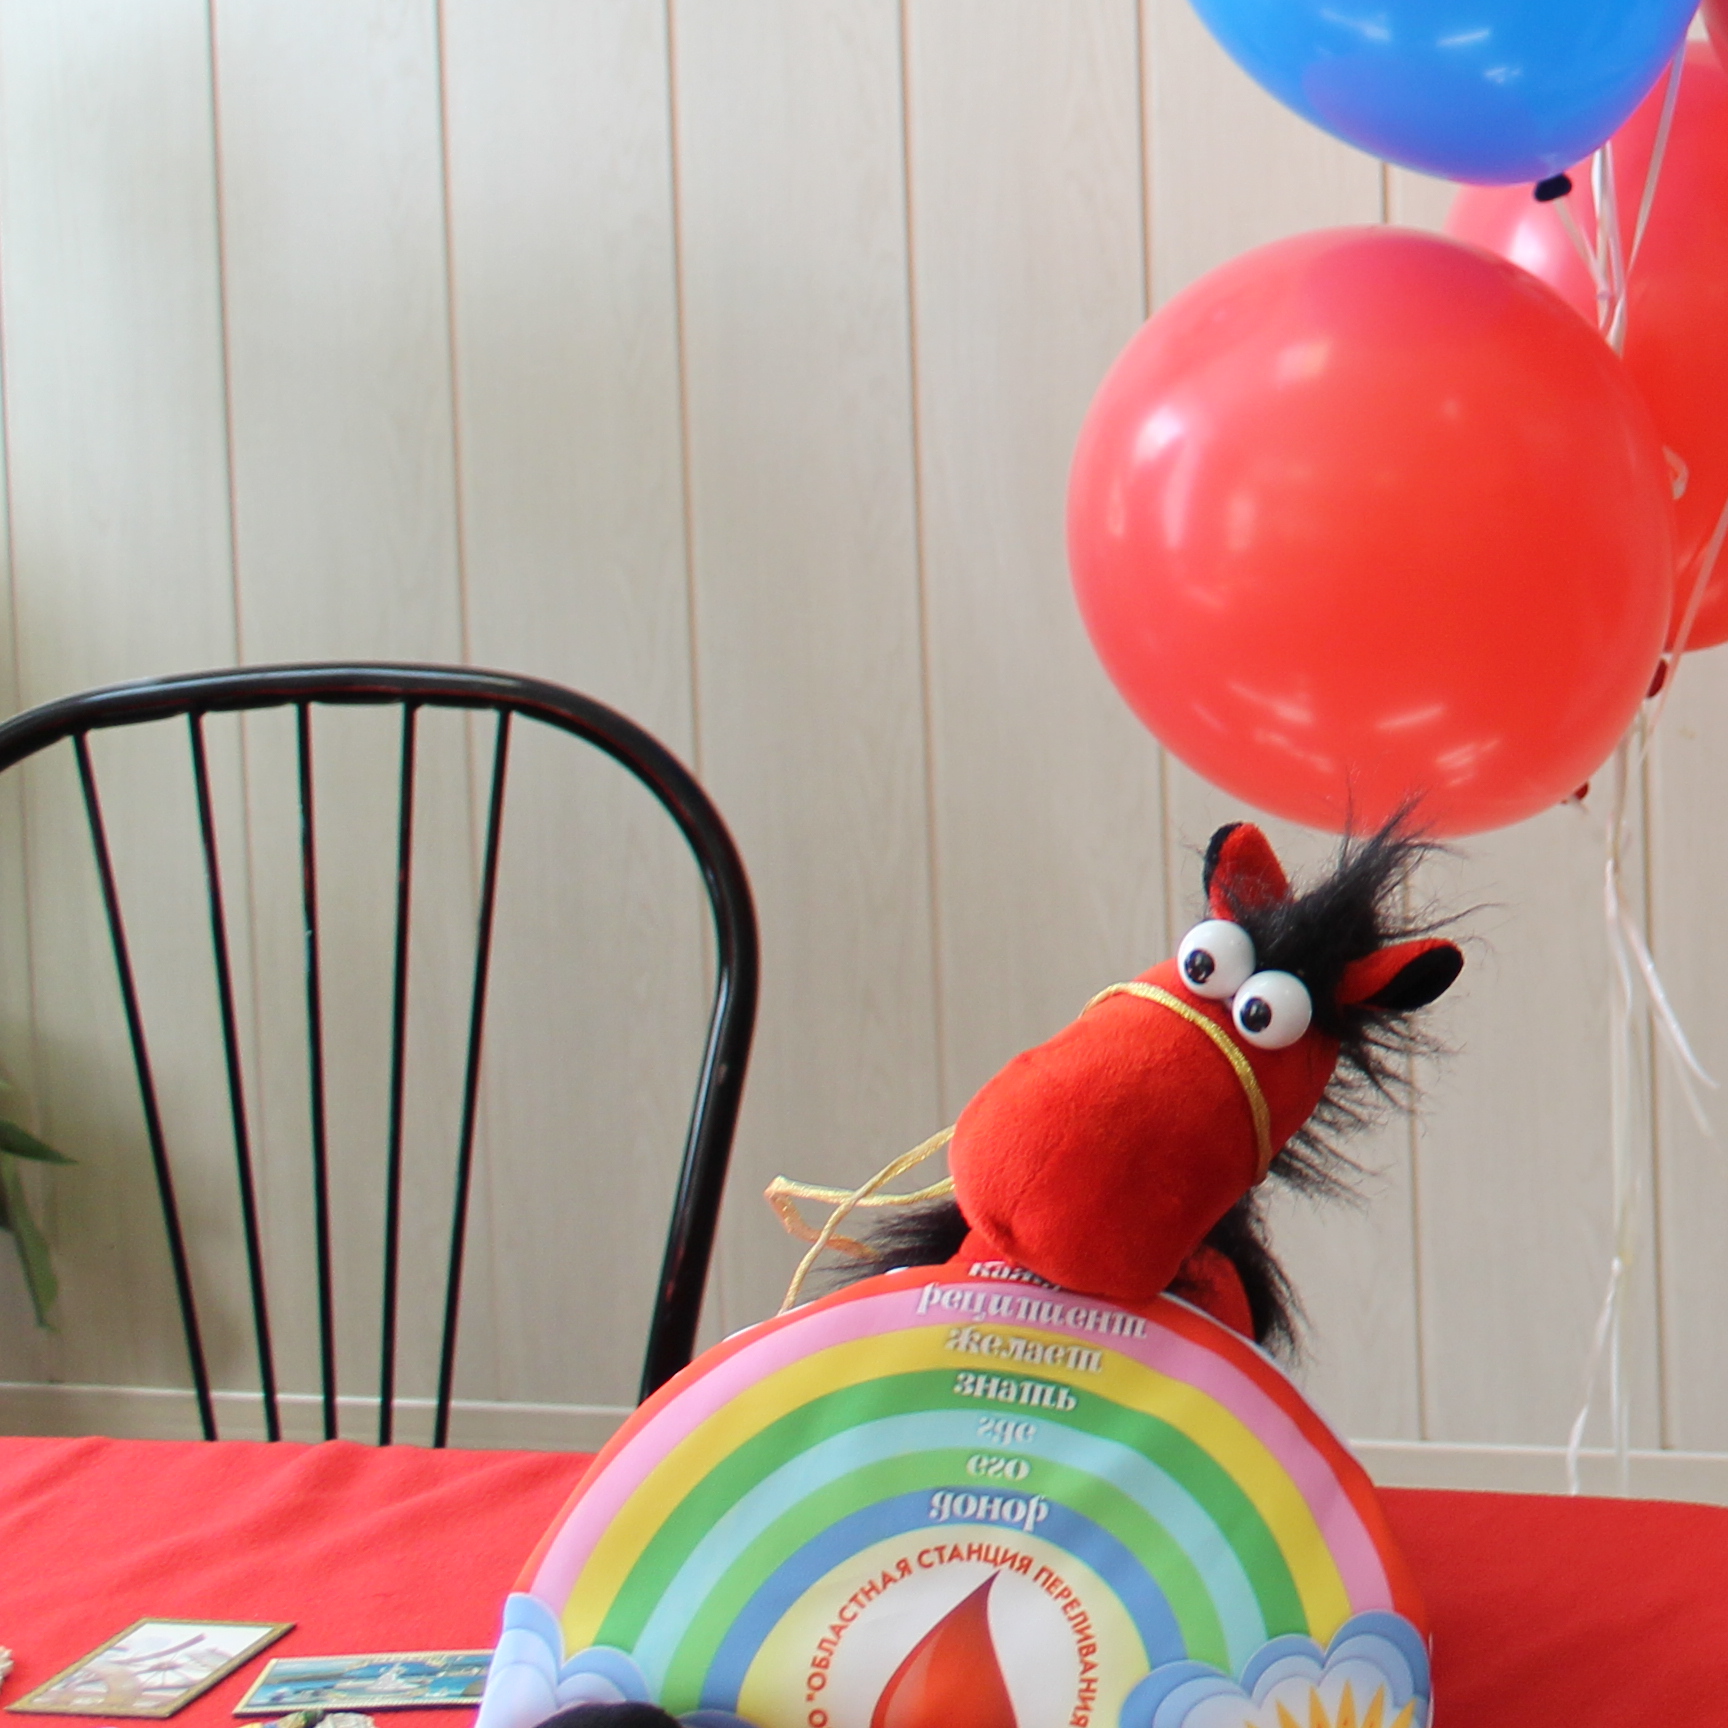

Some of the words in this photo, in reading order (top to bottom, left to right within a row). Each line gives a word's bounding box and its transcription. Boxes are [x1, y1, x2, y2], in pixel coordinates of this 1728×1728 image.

[916, 1282, 1148, 1339] реципиент
[945, 1326, 1103, 1372] желает
[953, 1371, 1078, 1411] знать
[976, 1416, 1037, 1447] где
[966, 1453, 1031, 1482] его
[928, 1489, 1050, 1533] донор
[917, 1543, 1034, 1575] СТАНЦИЯ
[1033, 1565, 1099, 1728] ПЕРЕЛИВАНИЯ
